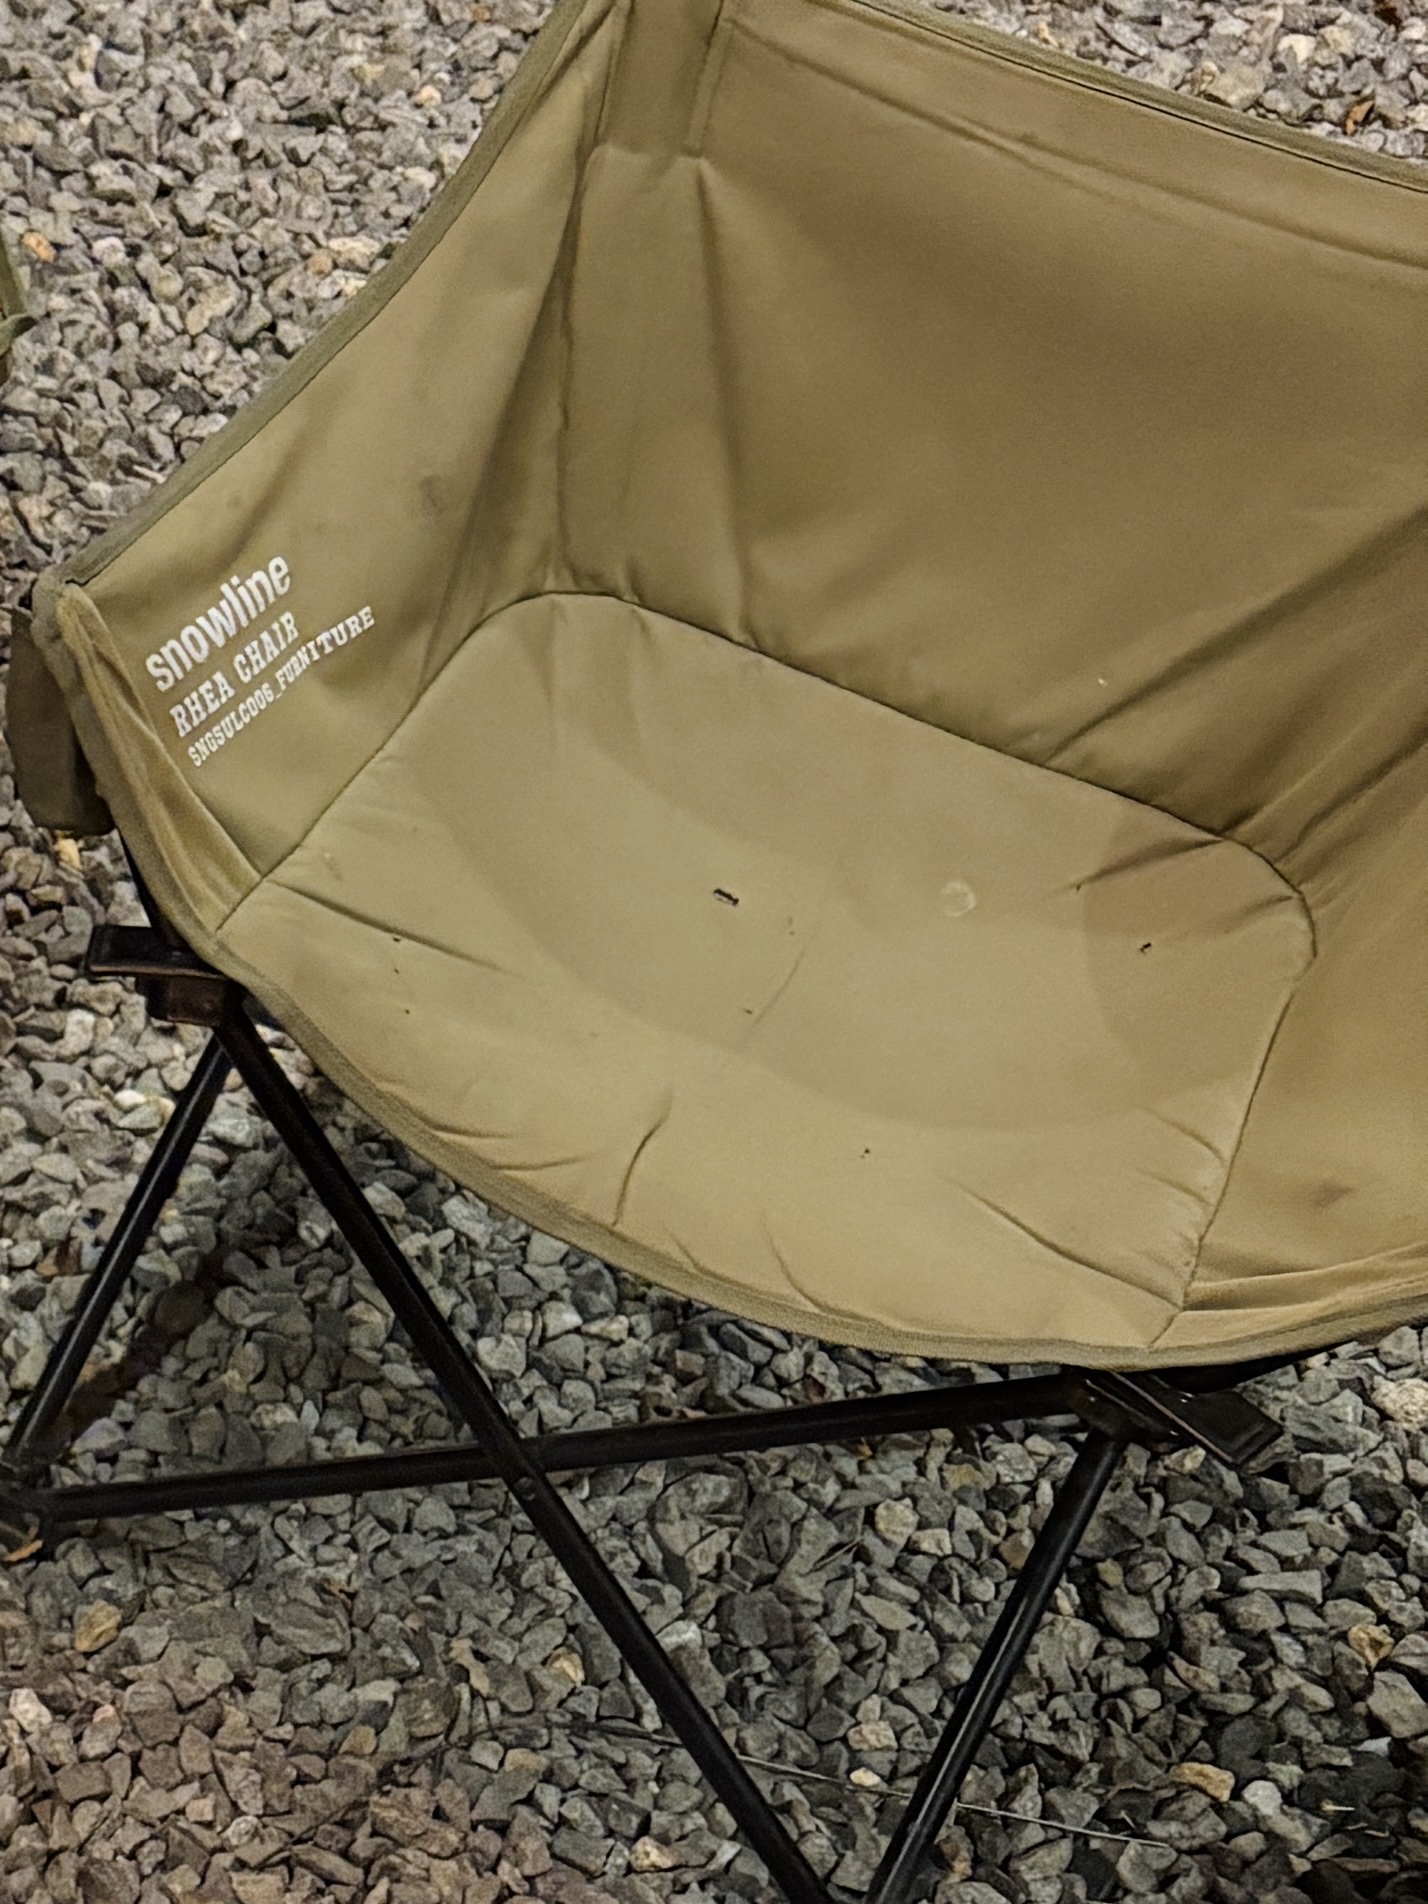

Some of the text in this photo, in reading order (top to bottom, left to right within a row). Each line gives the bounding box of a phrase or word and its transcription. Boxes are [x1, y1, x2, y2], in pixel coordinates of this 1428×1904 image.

[145, 556, 291, 692] snowline
[169, 610, 300, 738] RHEA CHAIR
